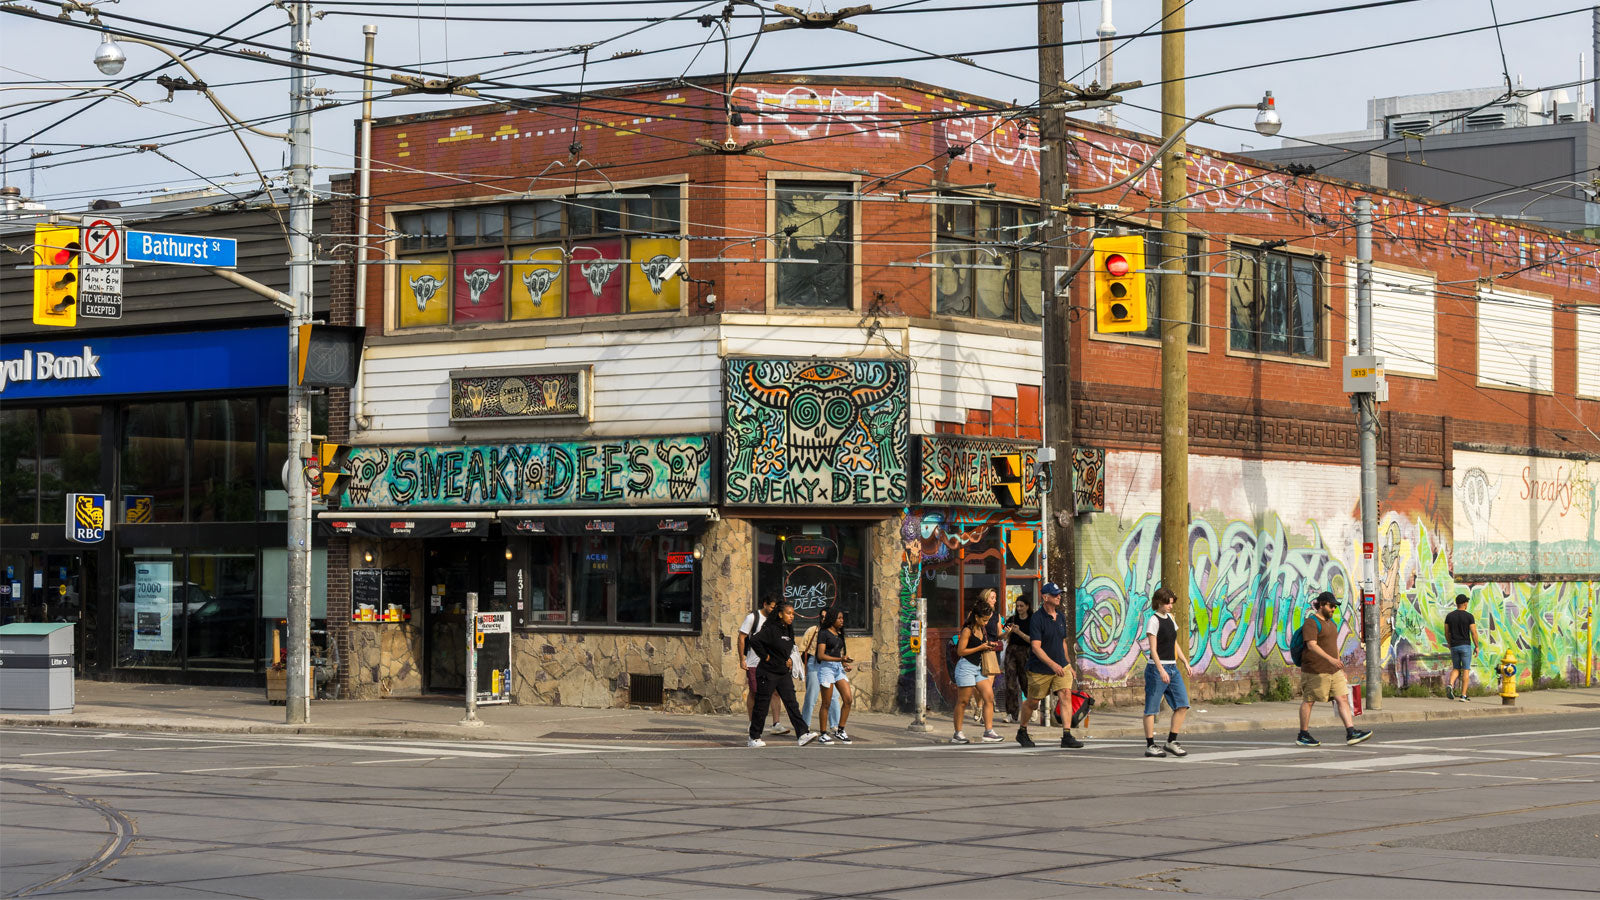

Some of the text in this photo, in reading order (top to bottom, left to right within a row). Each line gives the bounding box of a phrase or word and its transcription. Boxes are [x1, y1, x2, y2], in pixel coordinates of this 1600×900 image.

[142, 235, 221, 259] Bathurst St
[82, 294, 121, 305] TTC VEHICLES
[86, 304, 116, 315] EXCEPTED
[36, 346, 101, 380] Bank
[389, 442, 655, 504] SNEAKY DEE'S
[727, 472, 820, 503] SNEAKY
[831, 470, 908, 503] DEE'S
[1520, 466, 1572, 517] Sneaky
[77, 528, 102, 539] RBC
[794, 545, 825, 555] OPEN
[783, 580, 827, 598] SNEAKY
